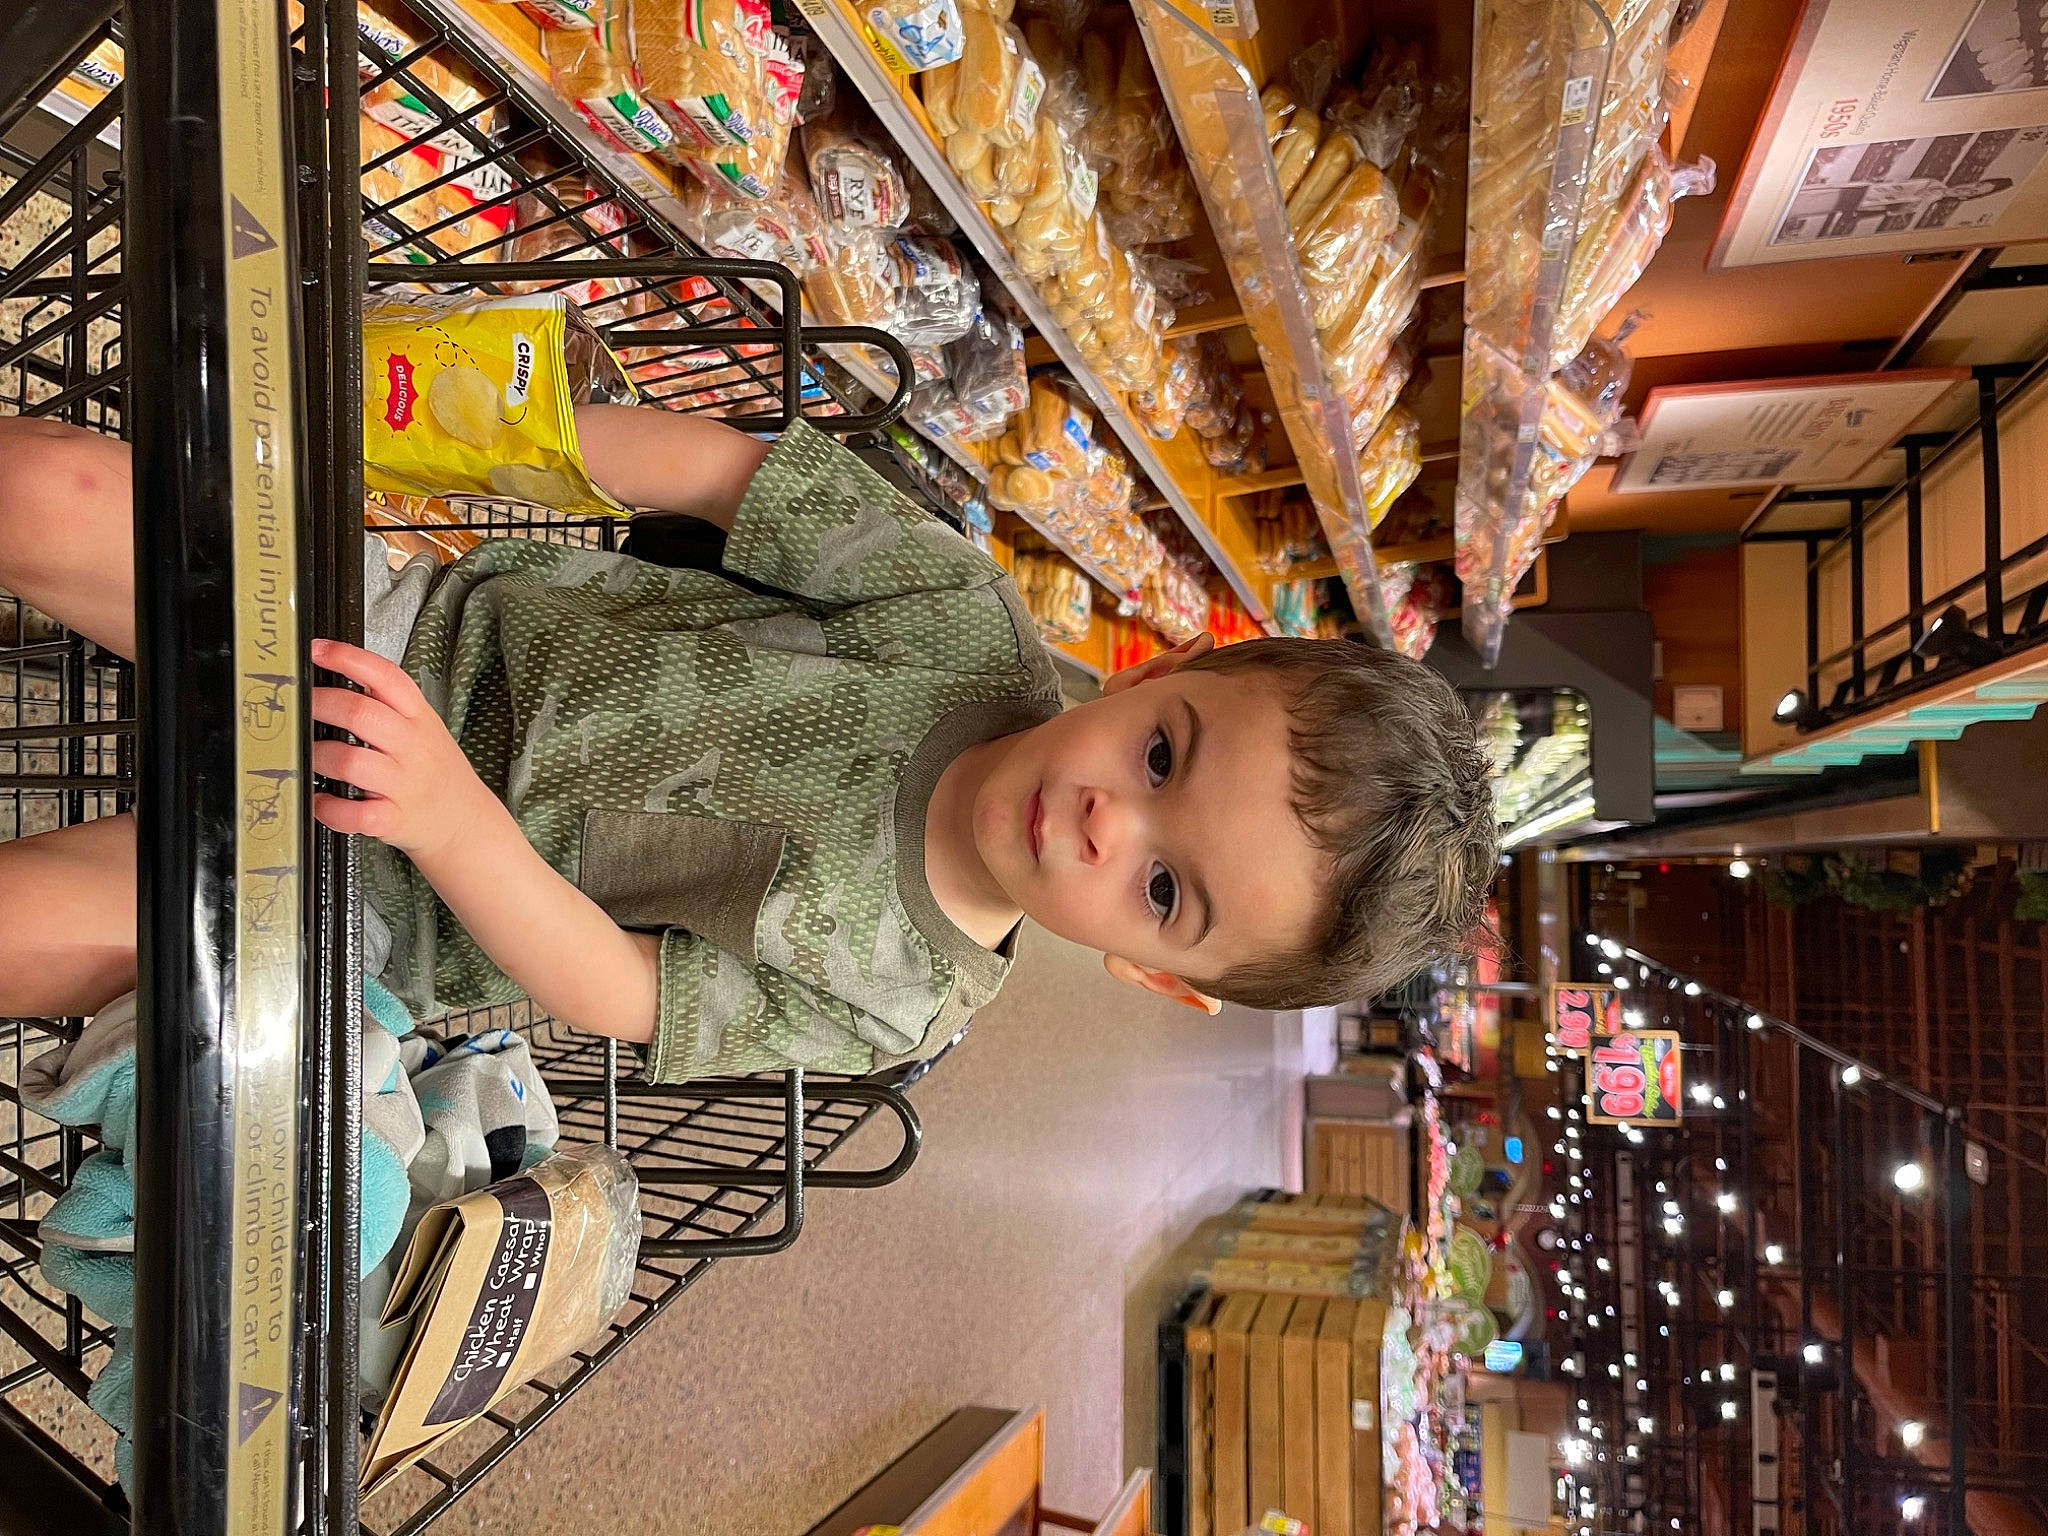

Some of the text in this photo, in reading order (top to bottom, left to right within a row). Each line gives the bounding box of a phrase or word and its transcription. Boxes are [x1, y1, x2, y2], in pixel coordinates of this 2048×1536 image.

[1820, 99, 1859, 139] 1950s
[849, 178, 865, 220] RYE
[393, 365, 407, 422] DELICIOUS
[513, 342, 530, 397] CRISPY
[249, 287, 282, 661] To avoid potential injury,
[247, 1122, 264, 1151] or
[245, 1163, 267, 1247] climb
[268, 1094, 290, 1343] allow children to
[531, 1220, 548, 1268] Whole
[243, 1256, 260, 1296] on
[453, 1212, 521, 1382] Chicken Caesar
[475, 1219, 537, 1372] Wheat Wrap
[241, 1303, 261, 1372] cart.
[505, 1317, 524, 1348] Half
